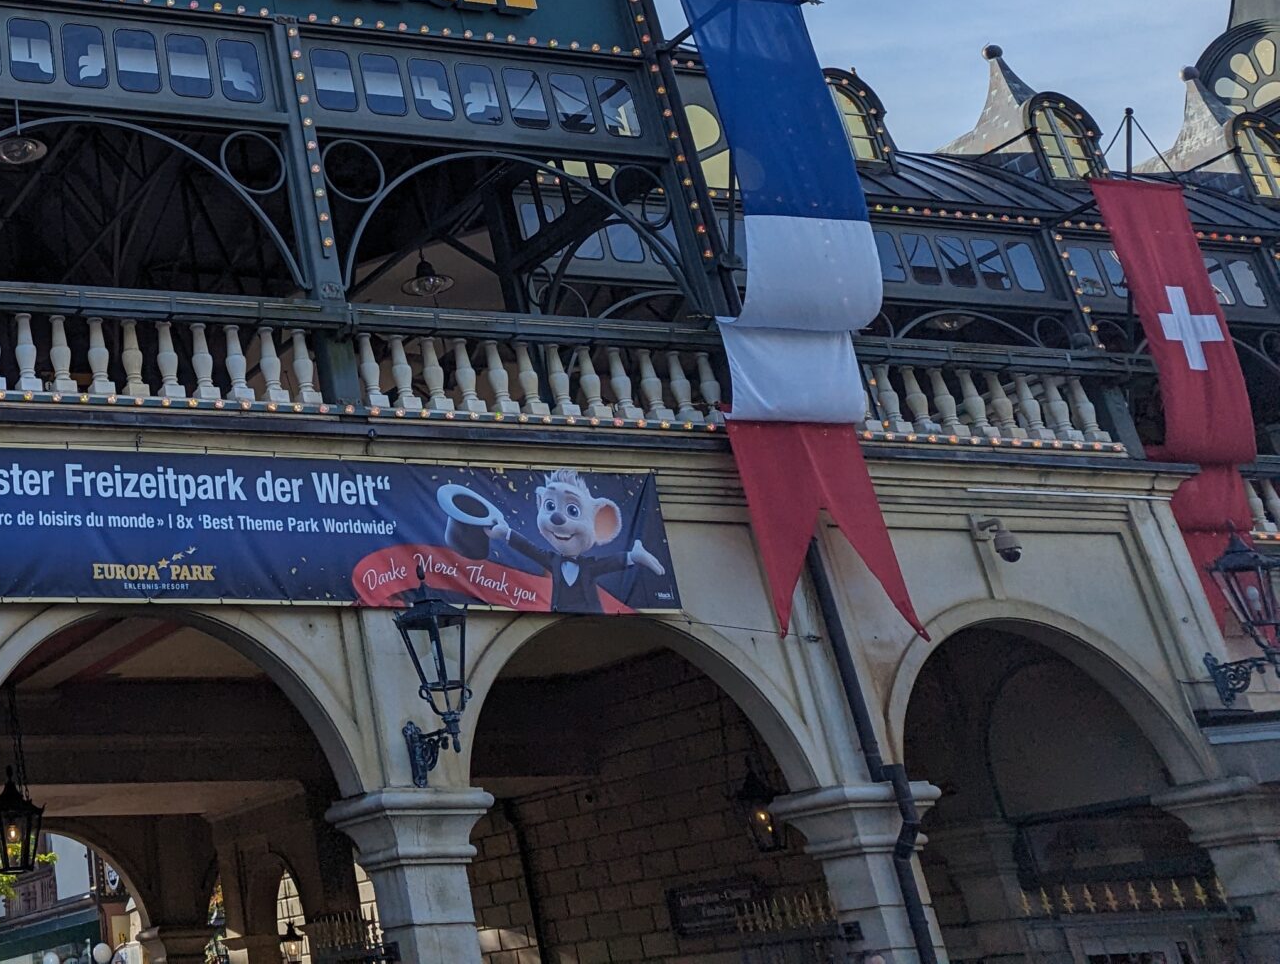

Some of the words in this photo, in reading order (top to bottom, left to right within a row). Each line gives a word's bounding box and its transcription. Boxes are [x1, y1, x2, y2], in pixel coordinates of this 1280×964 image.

[65, 463, 247, 506] Freizeitpark
[256, 470, 303, 503] der
[17, 510, 34, 526] de
[39, 510, 82, 527] loisirs
[86, 511, 103, 527] du
[108, 513, 154, 529] monde
[176, 514, 194, 530] 8x
[237, 515, 284, 532] Theme
[288, 517, 319, 533] Park
[93, 563, 160, 581] EUROPA
[170, 564, 215, 581] PARK
[363, 558, 407, 590] Danke
[413, 553, 458, 577] Merci
[466, 565, 509, 595] Thank
[511, 589, 536, 606] you
[124, 582, 190, 590] ERLEBNIS-RESORT
